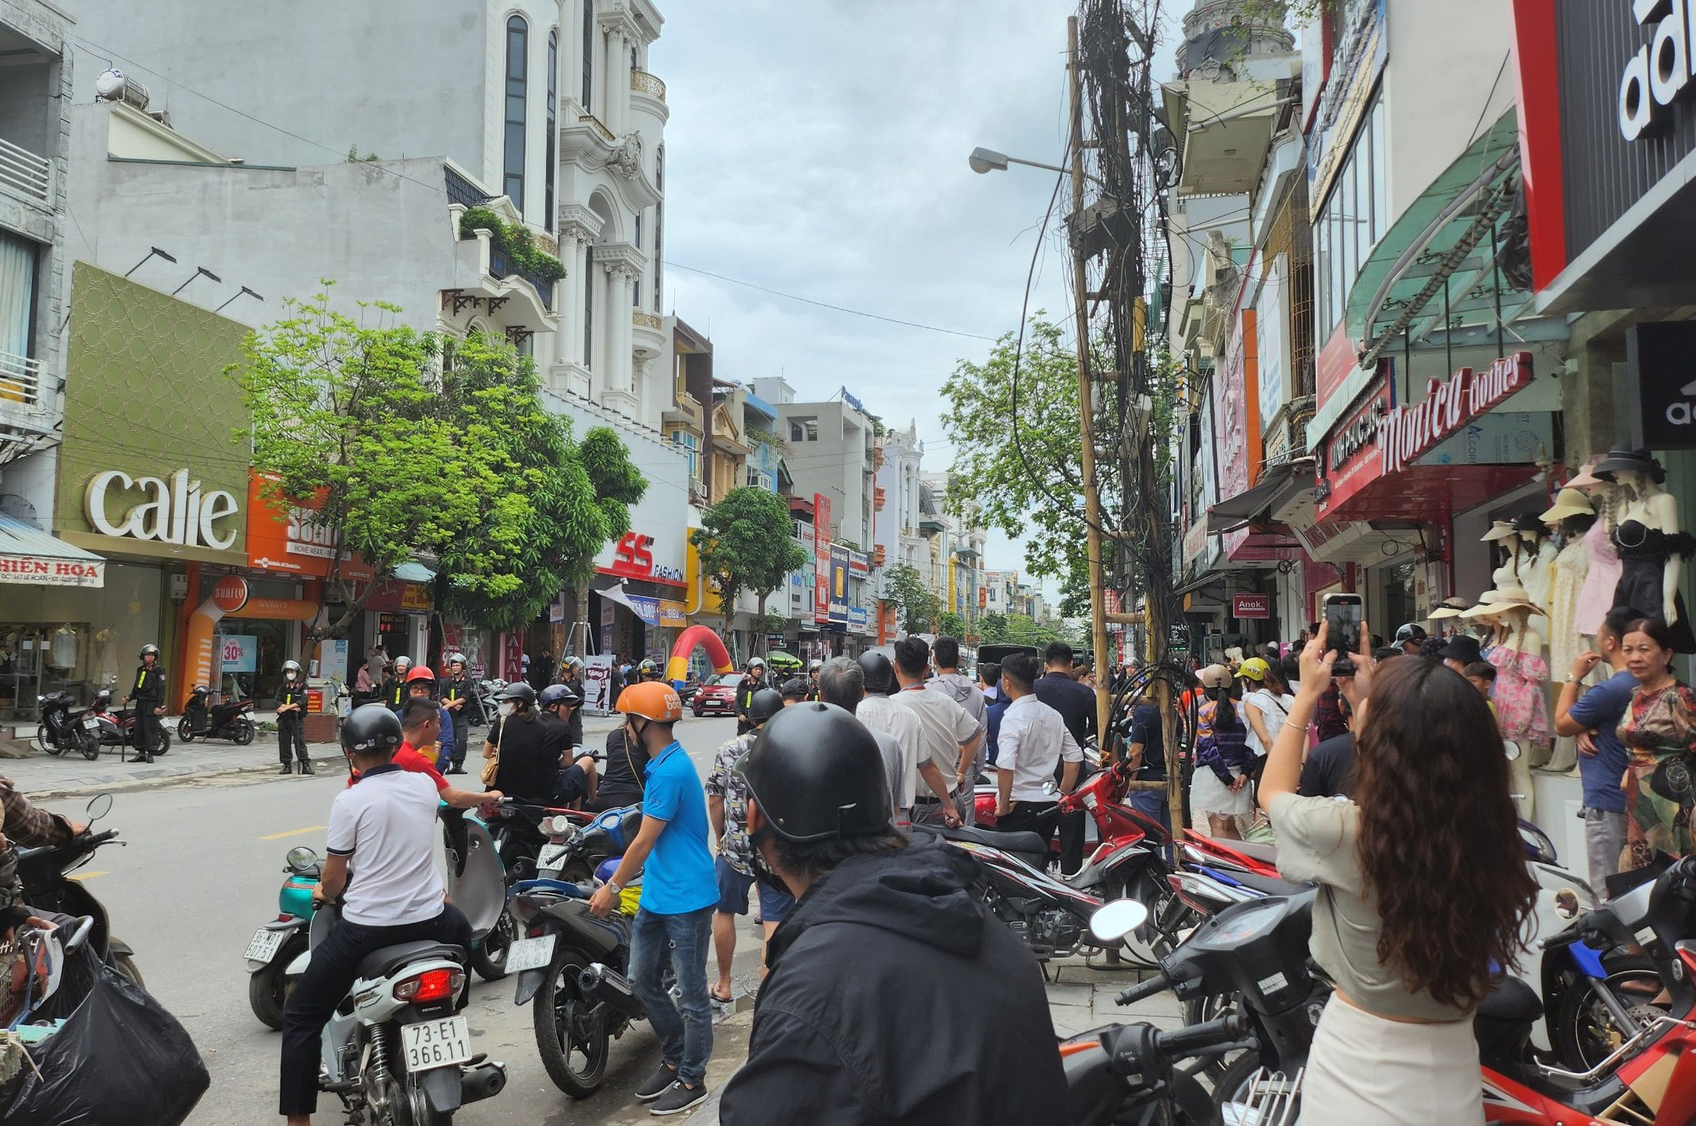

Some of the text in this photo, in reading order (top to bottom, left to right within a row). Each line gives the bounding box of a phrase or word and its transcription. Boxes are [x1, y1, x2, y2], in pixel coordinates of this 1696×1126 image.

[654, 565, 684, 582] FASHION
[215, 588, 244, 599] SUNFLY
[224, 645, 244, 661] 30%
[412, 1020, 456, 1045] 73-E1
[410, 1039, 465, 1067] 366.11
